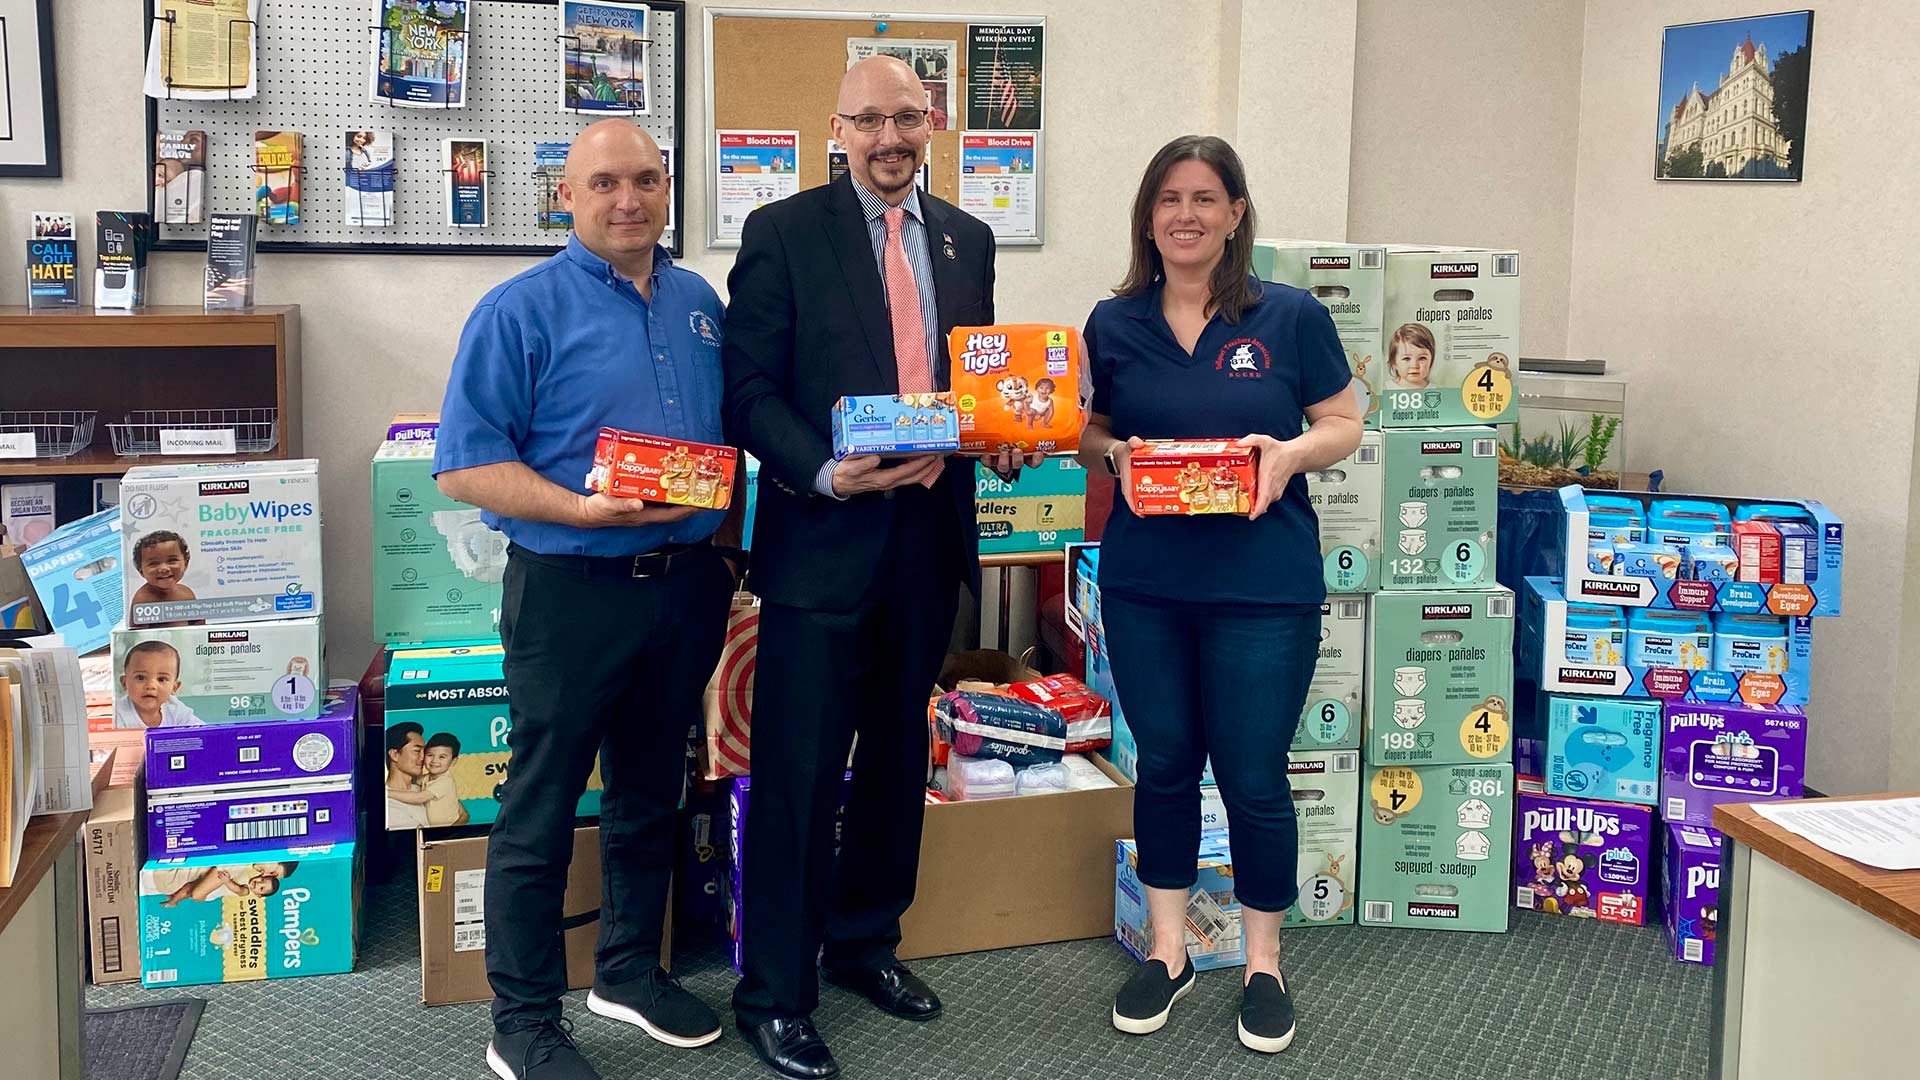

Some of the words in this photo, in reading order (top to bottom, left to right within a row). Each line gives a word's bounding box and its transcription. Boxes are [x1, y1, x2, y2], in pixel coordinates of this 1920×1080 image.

[577, 6, 592, 14] GET
[597, 8, 608, 17] TO
[610, 10, 636, 19] KNOW
[578, 15, 600, 24] NEW
[605, 19, 634, 29] YORK
[408, 23, 438, 37] NEW
[979, 27, 1015, 35] MEMORIAL
[405, 36, 442, 50] YORK
[975, 35, 1007, 43] WEEKEND
[746, 137, 770, 145] Blood
[772, 137, 793, 145] Drive
[160, 150, 192, 159] LEAVE
[258, 153, 277, 164] CHILD
[278, 153, 293, 164] CARE
[32, 244, 72, 254] CALL
[42, 255, 72, 264] OUT
[32, 264, 74, 279] HATE
[1433, 265, 1477, 273] KIRKLAND
[1331, 302, 1360, 315] pañales
[1416, 308, 1450, 323] diapers
[1457, 306, 1493, 322] pañales
[967, 333, 1007, 352] Hey
[1053, 334, 1061, 342] 4
[960, 351, 1011, 374] Tiger
[1477, 370, 1494, 392] 4
[1390, 393, 1422, 409] 198
[854, 415, 886, 423] Gerber
[960, 414, 975, 423] 22
[1393, 411, 1414, 421] diapers
[395, 429, 432, 440] Pull-Ups
[201, 481, 248, 491] KIRKLAND
[1409, 486, 1438, 498] diapers
[1444, 485, 1474, 498] pañales
[11, 499, 33, 507] BECOME
[1328, 493, 1358, 505] pañales
[1044, 504, 1053, 517] 7
[200, 526, 270, 537] FRAGRANCE
[980, 523, 1008, 531] ULTRA
[1038, 531, 1057, 541] 100
[1456, 543, 1471, 562] 6
[30, 550, 83, 576] DIAPERS
[1339, 550, 1353, 570] 6
[1390, 559, 1423, 574] 132
[1626, 566, 1656, 575] Gerber
[1393, 575, 1414, 585] diapers
[1585, 581, 1638, 592] KIRKLAND
[1678, 587, 1709, 597] Immune
[1680, 594, 1706, 604] Support
[1730, 590, 1752, 599] Brain
[1773, 590, 1809, 602] Developing
[51, 583, 102, 629] 4
[1722, 599, 1760, 608] Development
[1780, 601, 1800, 611] Eyes
[136, 605, 161, 616] 900
[1424, 606, 1470, 614] KIRKLAND
[196, 644, 225, 656] diapers
[231, 643, 260, 655] pañales
[1406, 648, 1442, 663] diapers
[1449, 647, 1485, 661] pañales
[1645, 646, 1672, 655] ProCare
[1732, 650, 1760, 659] ProCare
[1562, 669, 1614, 679] KIRKLAND
[1653, 673, 1683, 683] Immune
[287, 677, 296, 694] 1
[1655, 681, 1680, 690] Support
[1703, 677, 1725, 686] Brain
[1744, 678, 1779, 689] Developing
[428, 689, 466, 700] MOST
[1696, 686, 1732, 695] Development
[1751, 688, 1771, 698] Eyes
[230, 696, 250, 708] 96
[1321, 704, 1335, 723] 6
[1475, 712, 1491, 733] 4
[1633, 710, 1644, 735] Free
[1670, 713, 1725, 732] Pull-Ups
[1381, 732, 1415, 749] 198
[1643, 711, 1656, 769] Fragrance
[990, 742, 1032, 756] goodnites
[1384, 751, 1405, 761] diapers
[1553, 763, 1563, 774] NOT
[1469, 780, 1504, 796] 198
[1553, 775, 1563, 790] FLUSH
[1390, 789, 1407, 811] 4
[1305, 804, 1335, 817] pañales
[92, 828, 104, 855] 64717
[1395, 861, 1433, 876] pañales
[1440, 864, 1477, 878] diapers
[106, 862, 115, 903] ALIMENTUM
[1608, 873, 1627, 881] 100%
[1314, 880, 1329, 900] 5
[1409, 907, 1456, 917] KIRKLAND
[160, 920, 172, 935] 96
[248, 898, 262, 969] swaddlers
[279, 887, 310, 969] Pampers
[155, 948, 171, 956] 1
[239, 934, 247, 969] dryness
